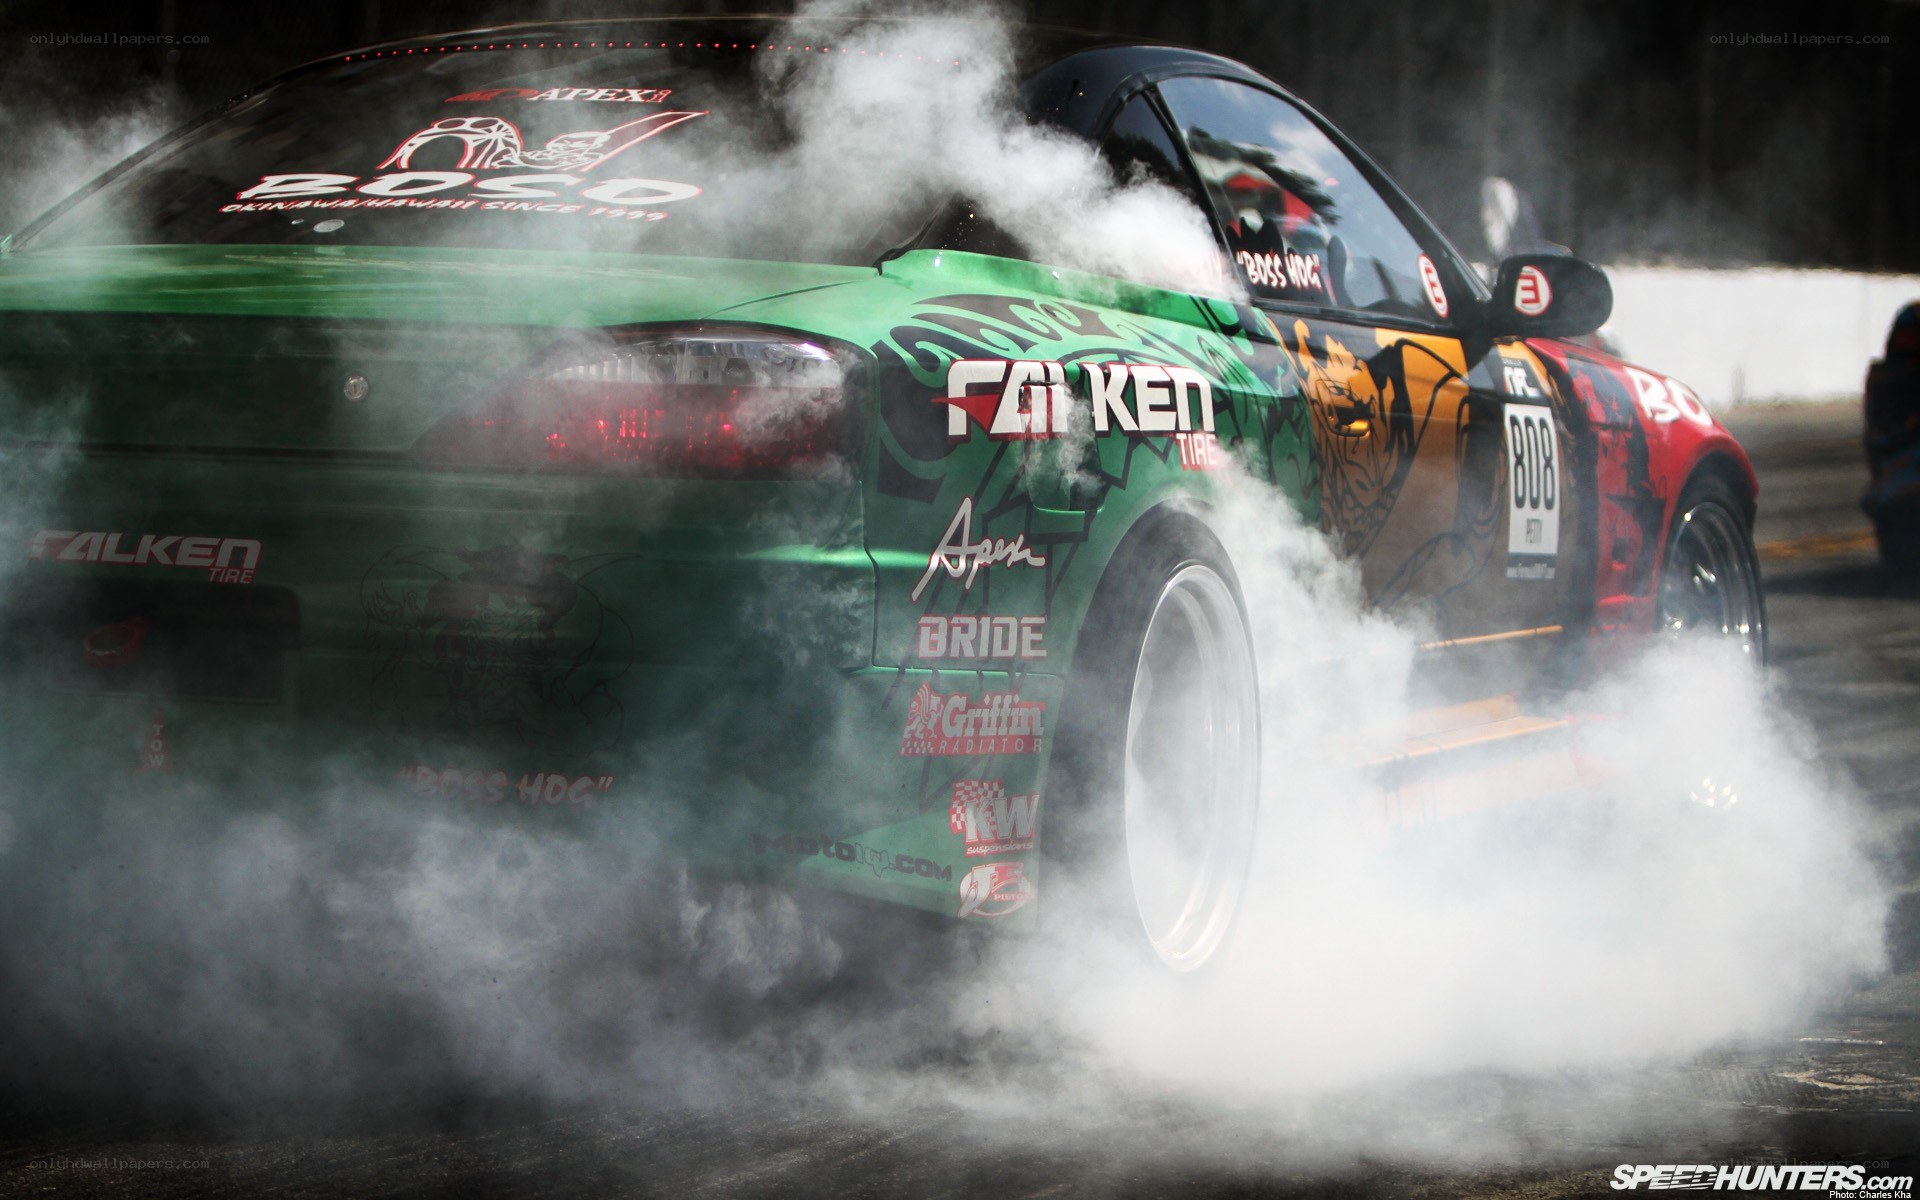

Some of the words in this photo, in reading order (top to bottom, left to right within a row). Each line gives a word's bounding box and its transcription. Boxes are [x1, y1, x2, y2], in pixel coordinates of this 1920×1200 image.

[480, 199, 585, 214] SINCE
[589, 204, 668, 221] 1999
[947, 358, 1217, 438] FALKEN
[1175, 432, 1219, 470] TIRE
[1509, 413, 1556, 511] 808
[29, 529, 262, 570] FALKEN
[207, 567, 254, 584] TIRE
[917, 614, 1048, 659] BRIDE
[941, 693, 1044, 738] Griffin
[149, 724, 164, 767] TOW
[938, 738, 1043, 753] RADIATOR
[965, 794, 1040, 842] KW
